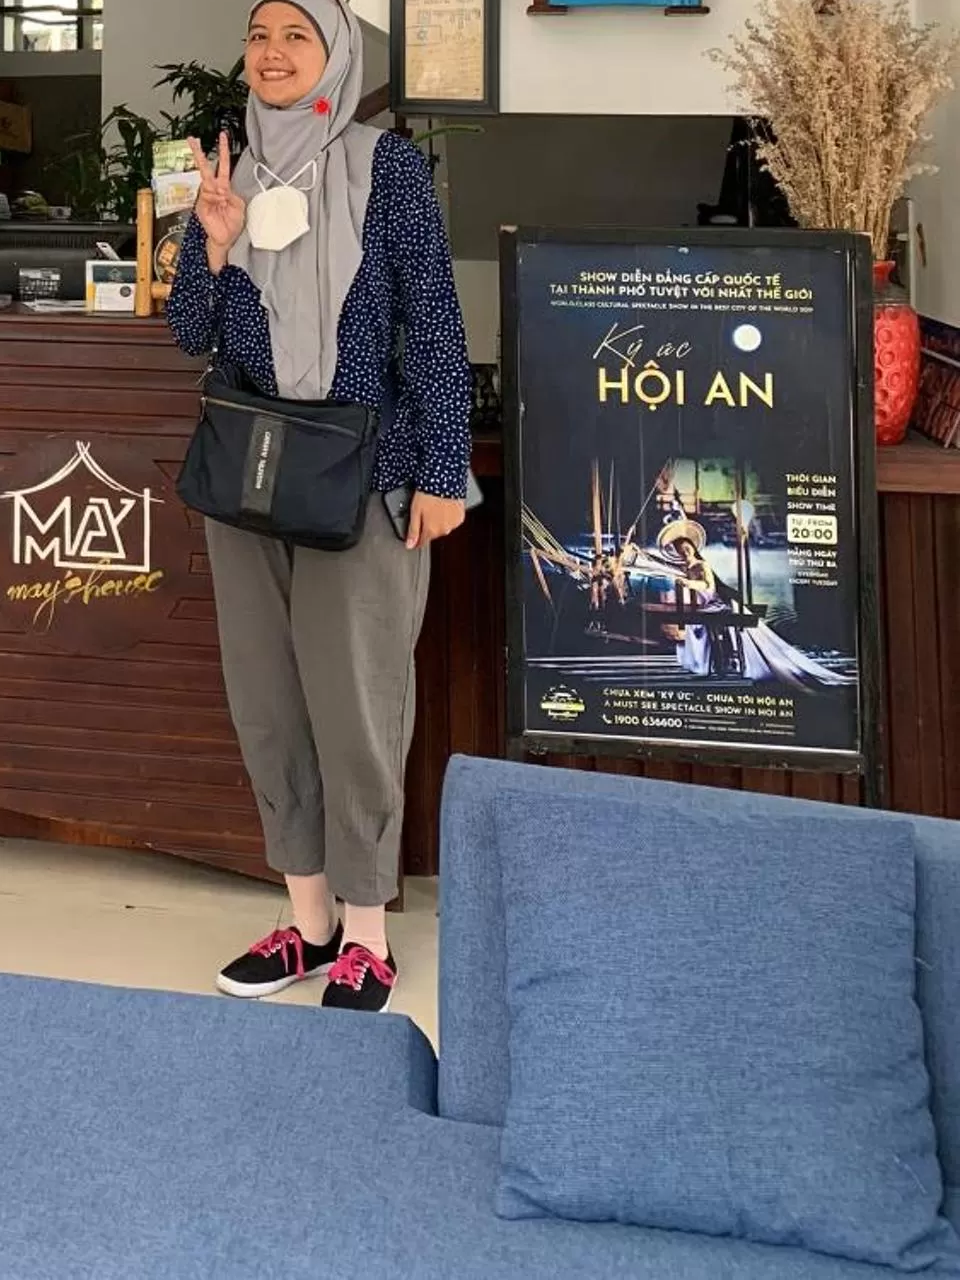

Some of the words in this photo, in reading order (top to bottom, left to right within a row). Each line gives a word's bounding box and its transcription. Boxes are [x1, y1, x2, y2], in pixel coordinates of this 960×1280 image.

[580, 271, 618, 282] SHOW
[621, 268, 652, 283] DIỄN
[695, 271, 720, 284] CẤP
[723, 272, 762, 286] QUỐC
[765, 272, 781, 286] TẾ
[549, 284, 569, 296] TẠI
[571, 283, 615, 295] THÀNH
[619, 283, 646, 296] PHỐ
[756, 286, 782, 300] THẾ
[593, 322, 645, 369] Ký
[598, 360, 685, 411] HỘI
[704, 370, 774, 409] AN
[811, 475, 837, 484] GIAN
[787, 501, 814, 510] SHOW
[815, 503, 837, 511] TIME
[792, 528, 833, 540] 20:00
[633, 689, 655, 699] XEM
[778, 698, 794, 707] AN
[613, 700, 638, 708] MUST
[641, 701, 658, 710] SEE
[660, 702, 712, 713] SPECTACLE
[714, 705, 742, 715] SHOW
[744, 707, 755, 716] IN
[779, 709, 794, 718] AN
[614, 714, 640, 725] 1900
